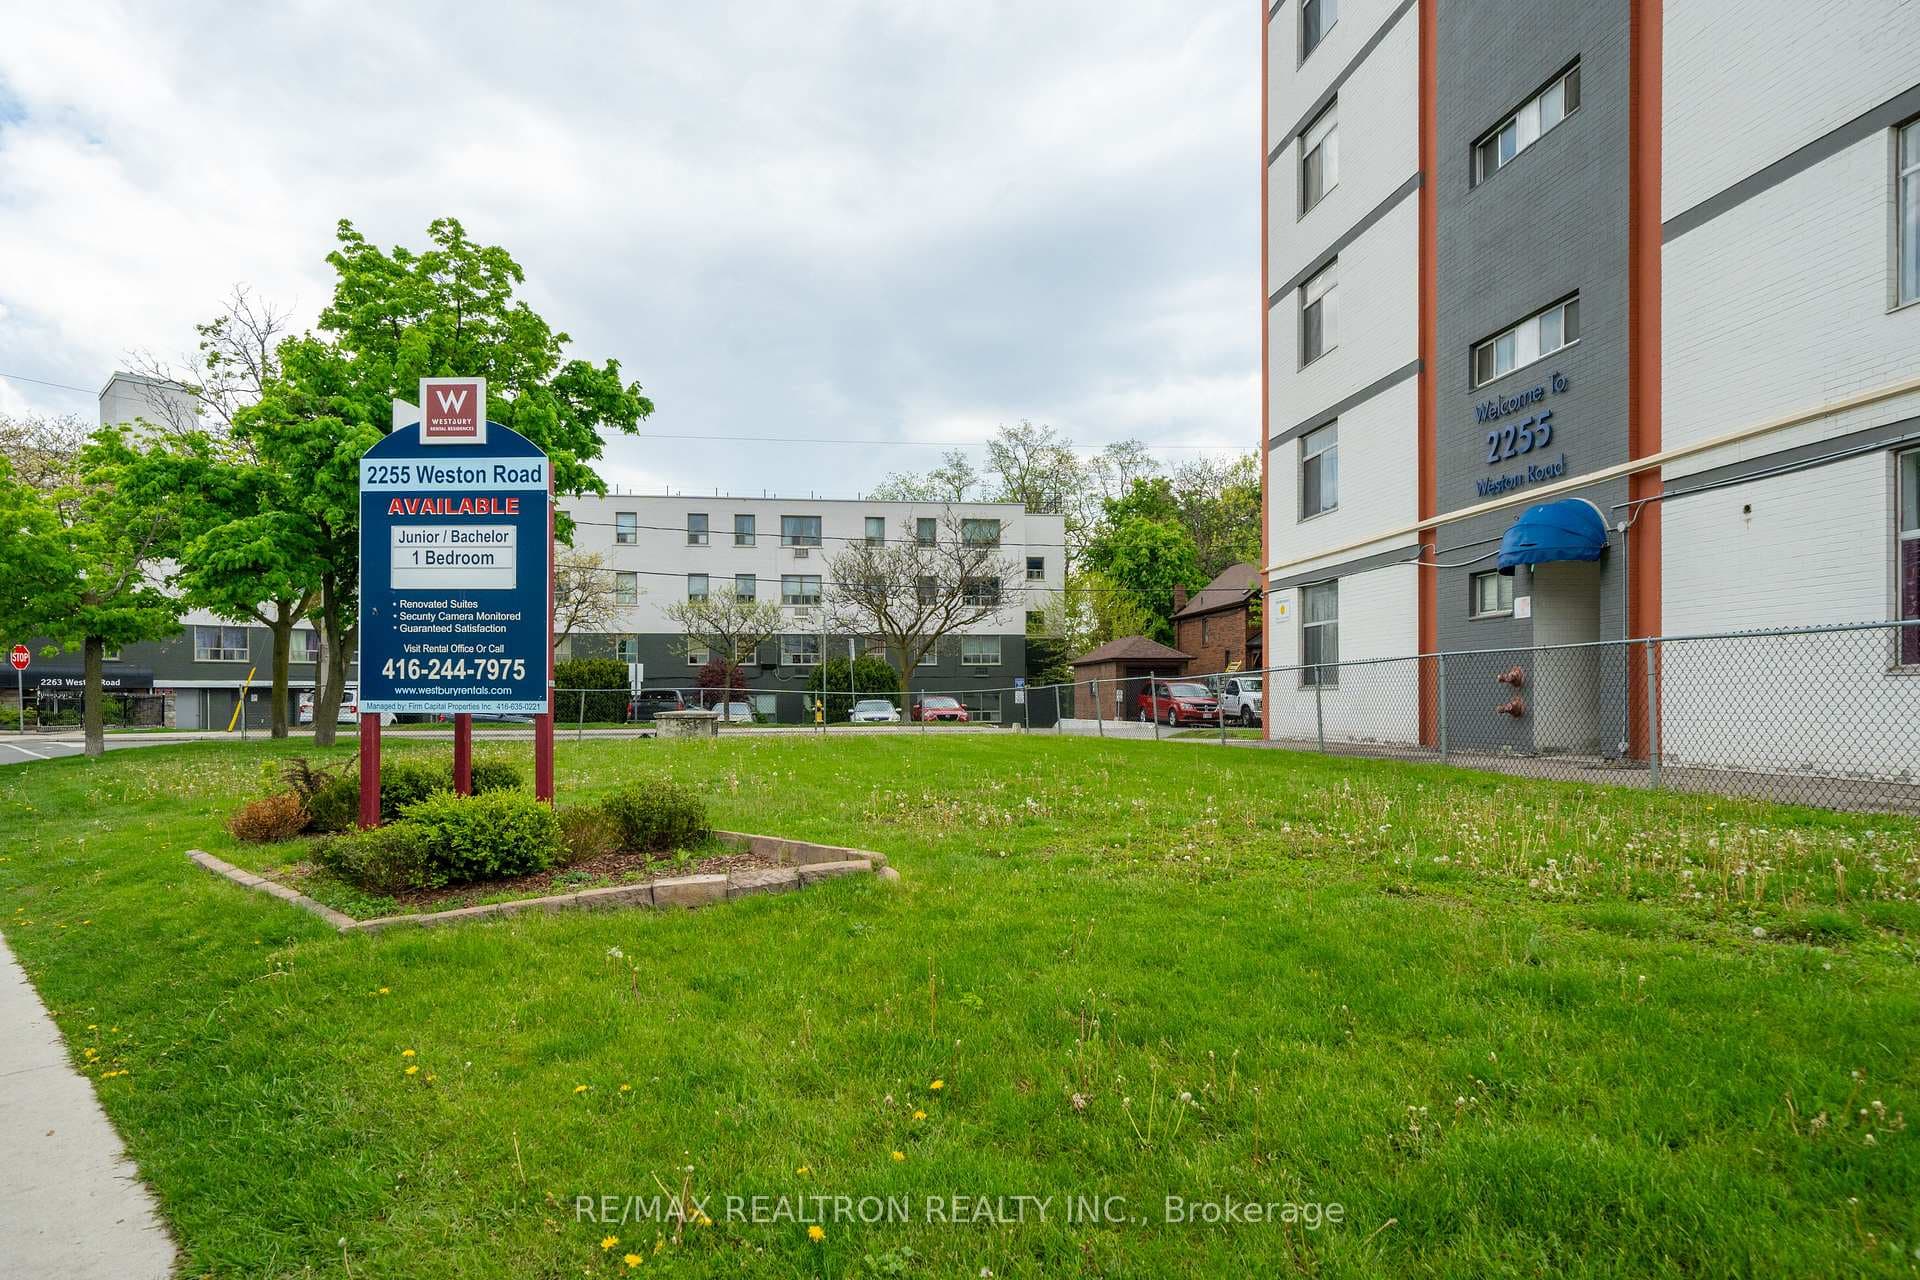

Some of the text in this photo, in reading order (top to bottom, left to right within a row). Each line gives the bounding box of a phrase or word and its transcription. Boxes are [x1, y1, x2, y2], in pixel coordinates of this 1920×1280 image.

[435, 389, 468, 414] W
[1475, 372, 1568, 423] Welcome To
[1487, 408, 1553, 464] 2255
[367, 464, 542, 484] 2255 Weston Road
[1476, 449, 1566, 497] Weston Road
[388, 497, 520, 515] AVAILABLE
[398, 529, 509, 544] Junior / Bachelor
[412, 550, 495, 565] 1 Bedroom
[400, 600, 478, 609] Renovated Suites
[400, 611, 521, 622] Security Camera Monitored
[400, 623, 507, 633] Guaranteed Satisfaction
[403, 644, 505, 653] Visit Rental Office Or Call
[12, 652, 28, 662] STOP
[382, 658, 526, 680] 416-244-7975
[394, 686, 512, 697] www.westburyrentals.com
[366, 702, 396, 711] Managed
[397, 702, 407, 711] by:
[408, 702, 423, 710] Firm
[424, 702, 447, 711] Capital
[448, 702, 480, 711] Properties
